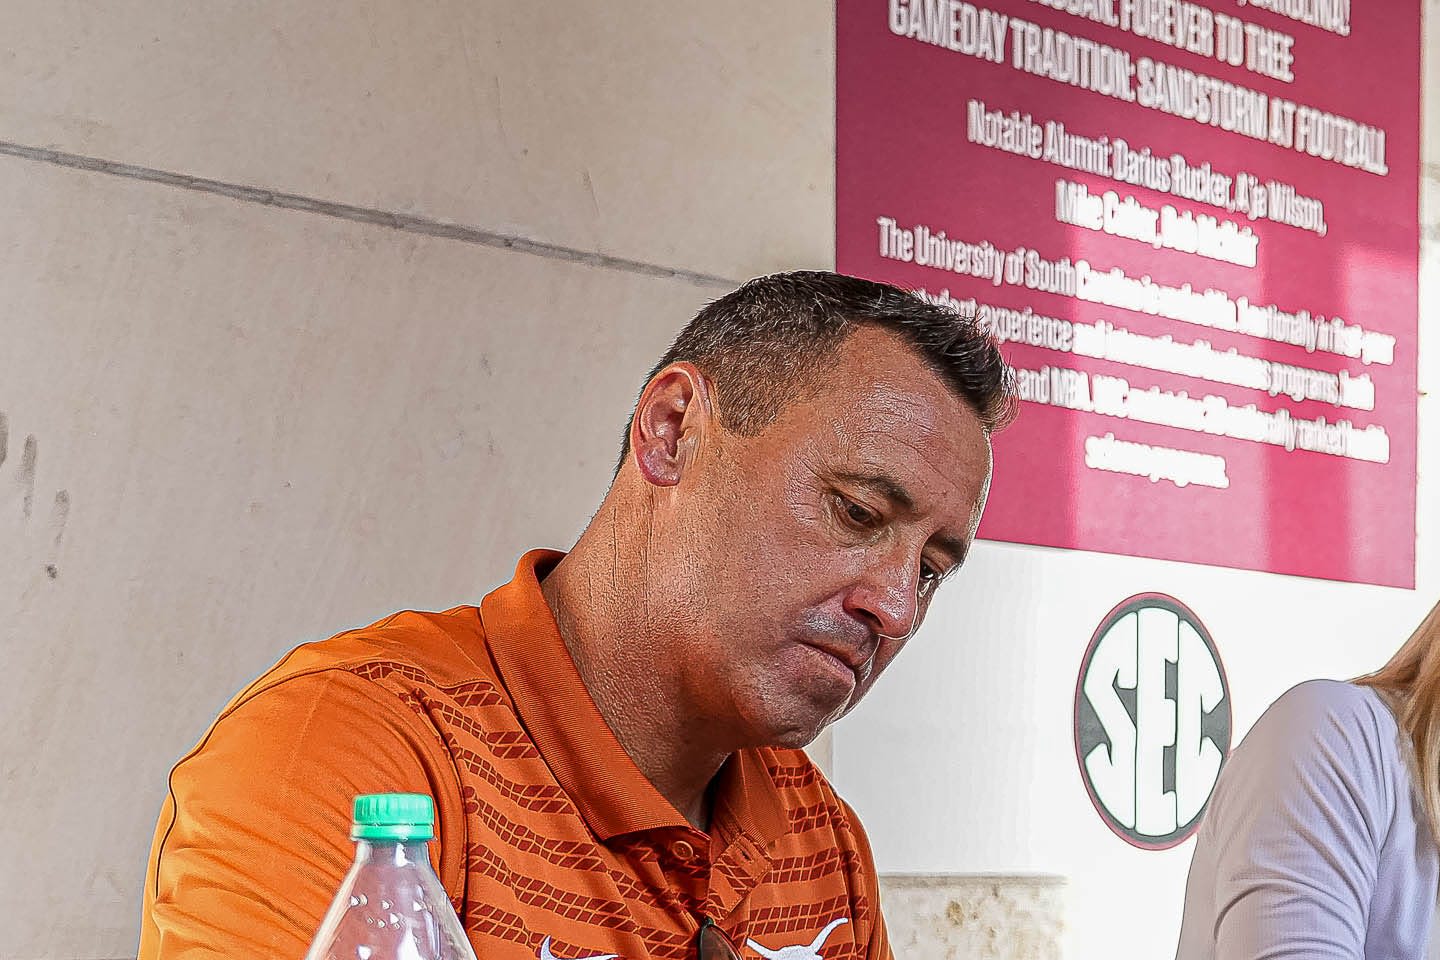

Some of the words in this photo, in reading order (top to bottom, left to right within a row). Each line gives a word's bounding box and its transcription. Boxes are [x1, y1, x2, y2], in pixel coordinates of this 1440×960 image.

[888, 0, 1009, 64] GAMEDAY
[1009, 17, 1136, 102] TRADITION:
[1136, 57, 1269, 142] SANDSTORM
[1268, 97, 1297, 148] AT
[1296, 105, 1388, 176] FOOTBALL
[1214, 12, 1244, 66] TO
[967, 99, 1043, 160] Notable
[1043, 119, 1113, 177] Alumni:
[1112, 137, 1171, 192] Darius
[1170, 154, 1236, 214] Rucker,
[1266, 179, 1328, 237] Wilson,
[877, 215, 914, 262] The
[913, 224, 1006, 287] University
[1004, 246, 1027, 286] of
[1025, 249, 1076, 298] South
[1083, 606, 1226, 838] SEC
